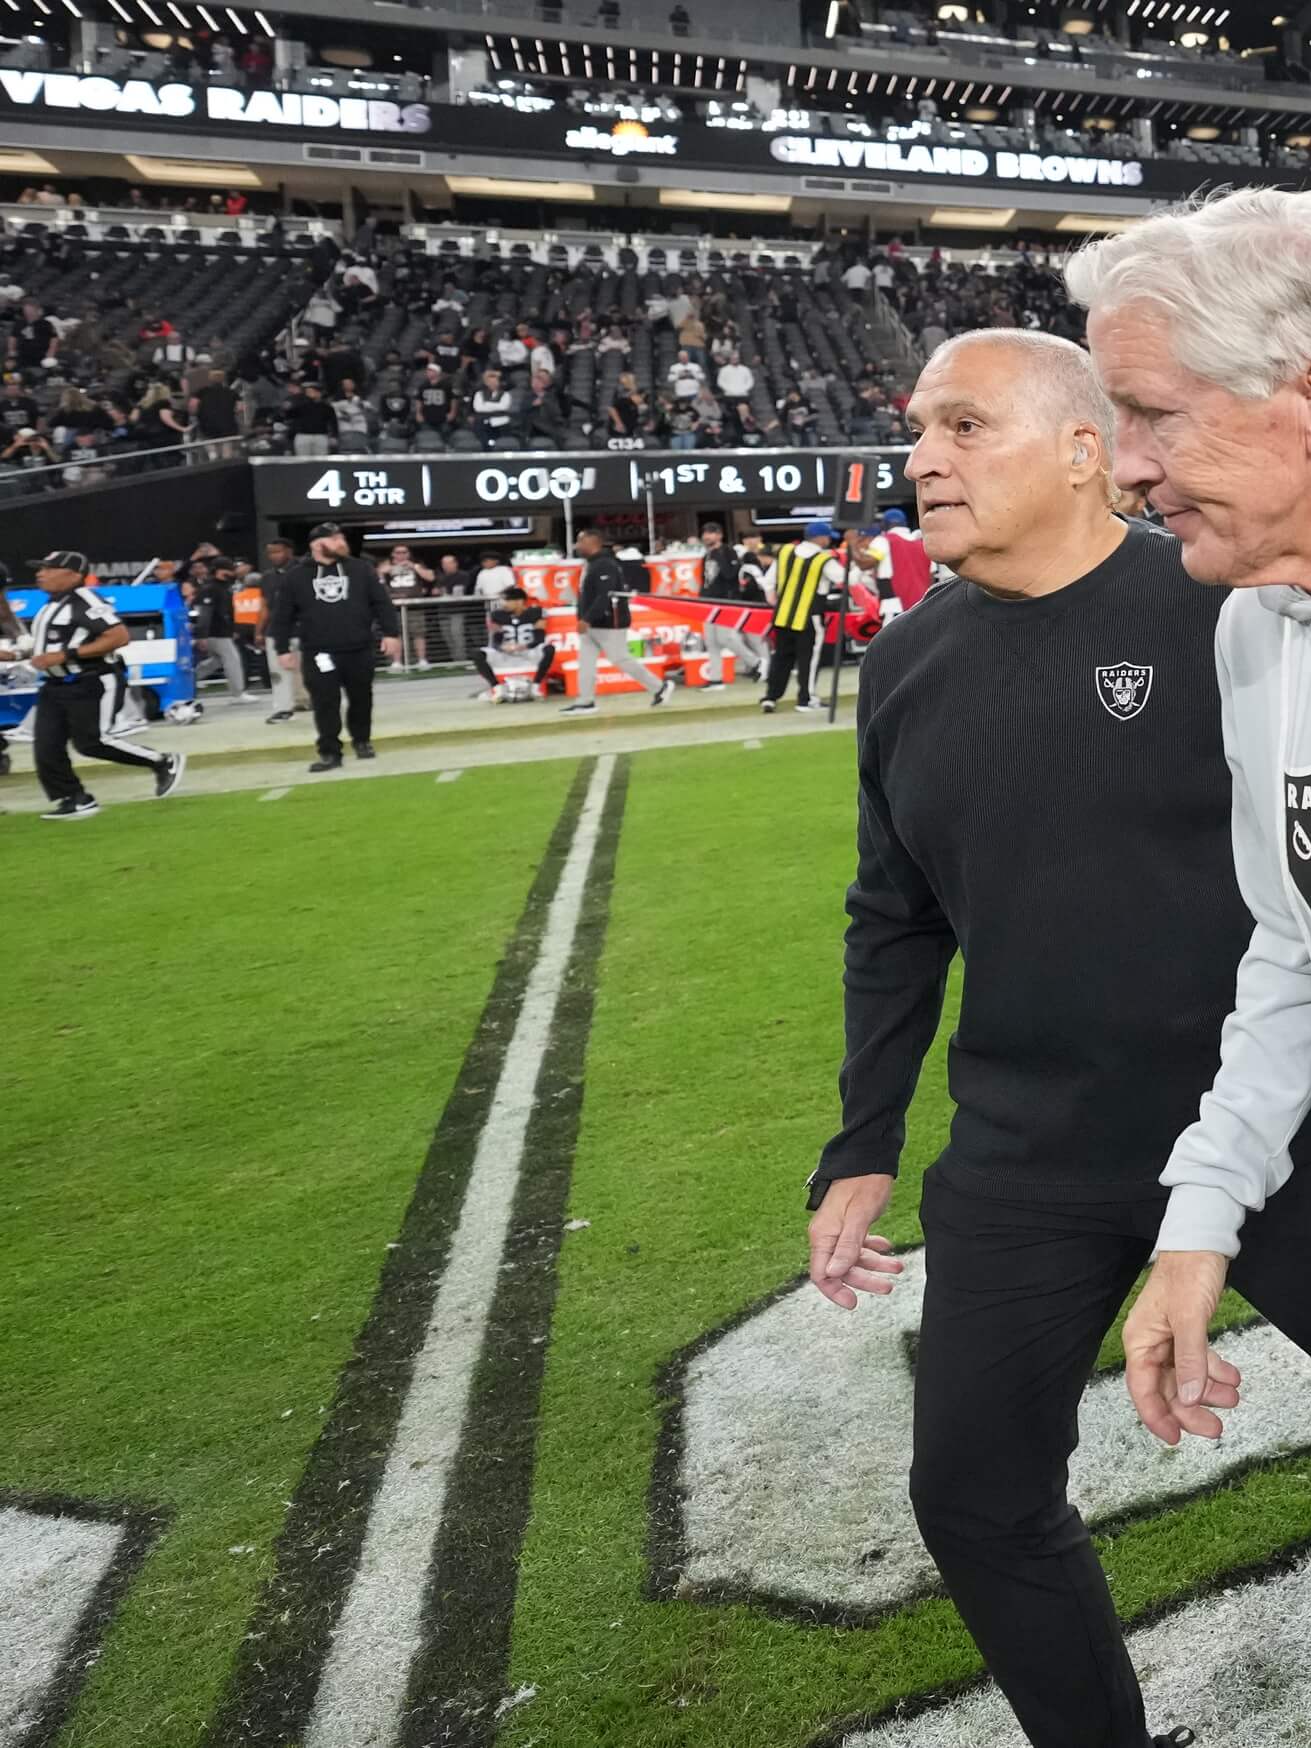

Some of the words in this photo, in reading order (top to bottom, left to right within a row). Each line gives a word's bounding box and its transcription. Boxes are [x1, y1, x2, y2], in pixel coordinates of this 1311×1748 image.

[0, 69, 195, 117] VEGAS
[207, 87, 432, 133] RAIDERS
[770, 136, 989, 176] CLEVELAND
[995, 152, 1143, 186] BROWNS
[608, 438, 645, 450] C134
[307, 470, 346, 507] 4
[353, 471, 387, 488] TH
[660, 464, 709, 494] 1ST
[719, 466, 746, 493] &
[759, 465, 801, 491] 10
[846, 463, 863, 502] 1
[354, 488, 405, 505] QTR
[1102, 669, 1146, 678] RAIDERS
